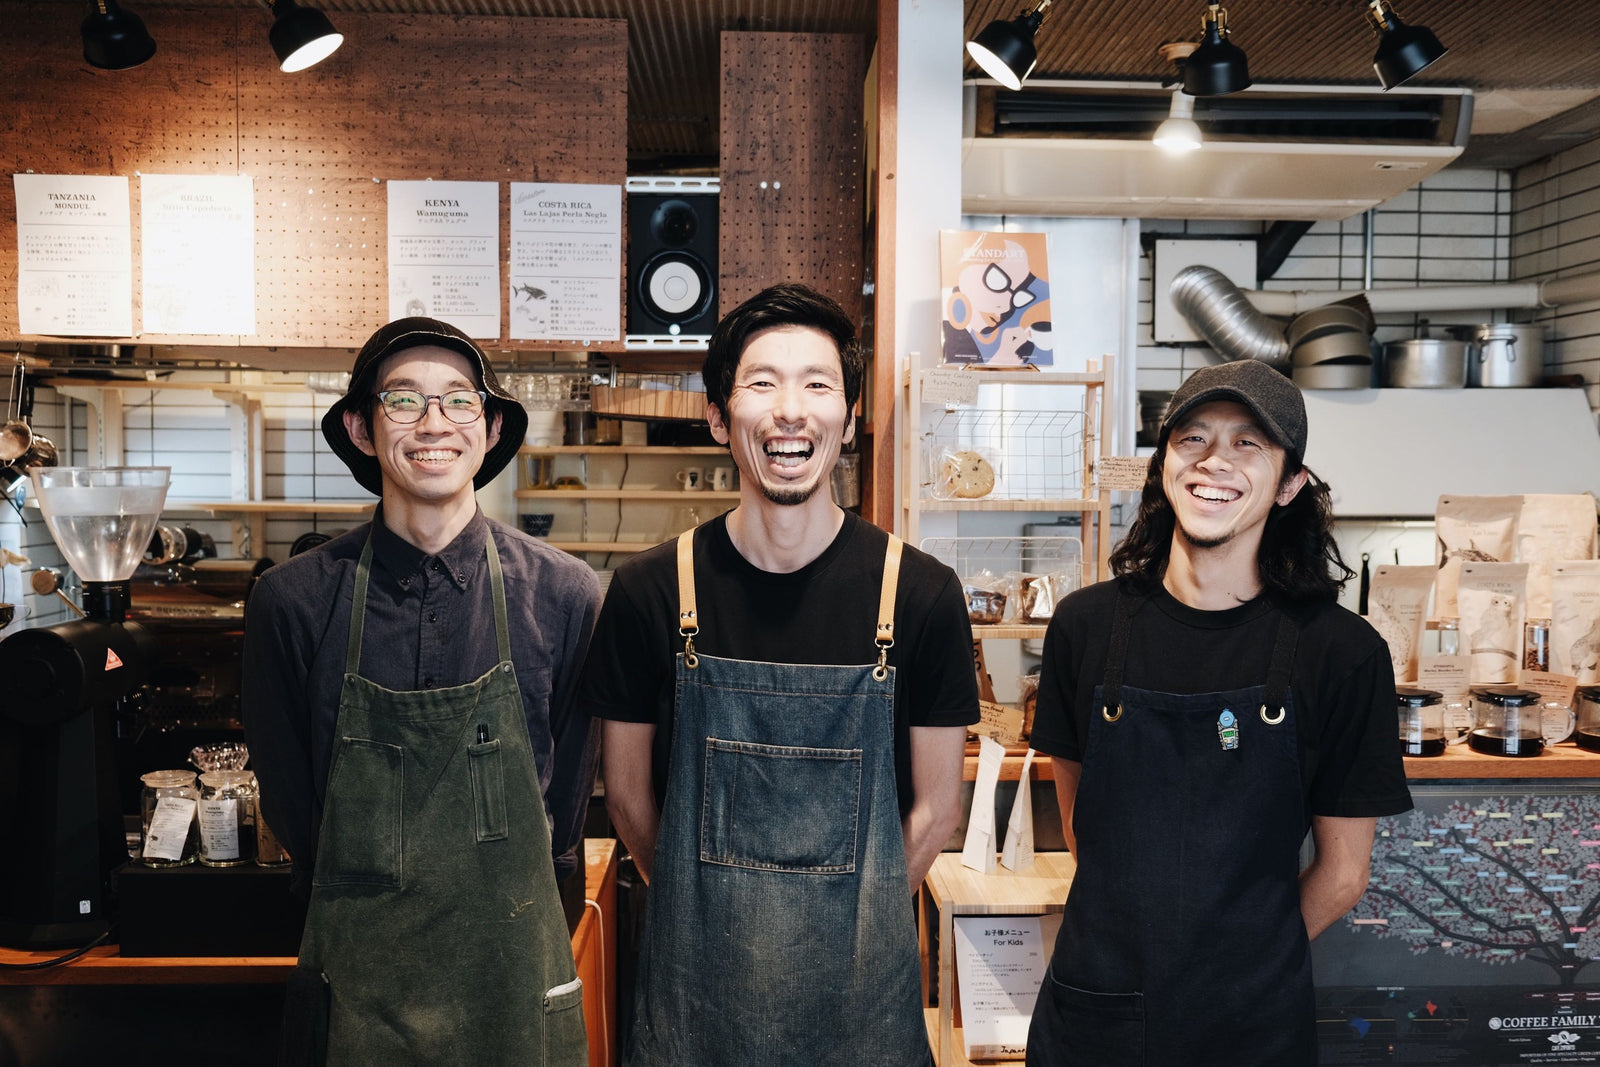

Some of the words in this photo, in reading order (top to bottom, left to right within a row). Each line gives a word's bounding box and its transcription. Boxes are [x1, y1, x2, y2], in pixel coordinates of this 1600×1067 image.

[48, 193, 96, 201] TANZANIA
[424, 199, 460, 207] KENYA
[538, 201, 567, 209] COSTA
[416, 210, 469, 218] Wamuguma
[540, 210, 561, 218] Lajas
[985, 929, 1030, 937] お子様メニュー
[1502, 1017, 1548, 1028] COFFEE
[1552, 1015, 1596, 1027] FAMILY
